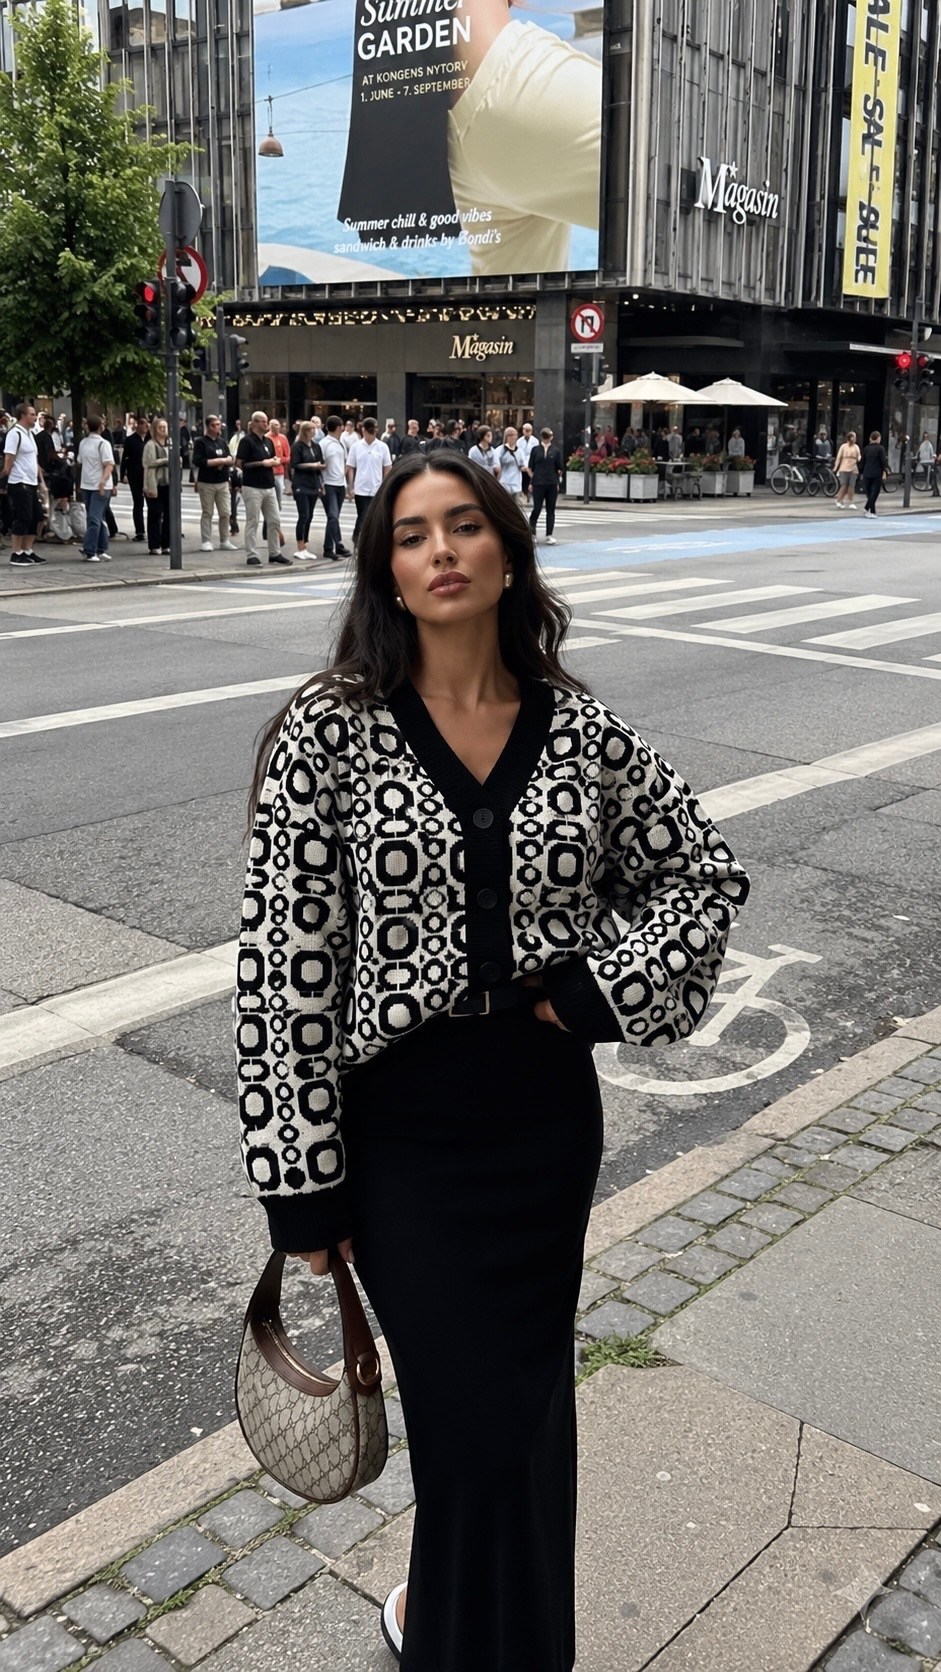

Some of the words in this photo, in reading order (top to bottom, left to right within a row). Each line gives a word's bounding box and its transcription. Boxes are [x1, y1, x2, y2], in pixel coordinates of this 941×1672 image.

[357, 15, 471, 60] GARDEN
[362, 74, 374, 86] AT
[376, 66, 424, 83] KONGENS
[426, 60, 469, 76] NYTORV
[360, 92, 368, 103] 1.
[369, 88, 394, 102] JUNE
[403, 86, 412, 97] 7.
[413, 77, 471, 96] SEPTEMBER
[694, 156, 779, 225] Magasin
[342, 217, 389, 233] Summer
[391, 213, 416, 229] chill
[418, 212, 427, 227] &
[429, 209, 460, 230] good
[462, 207, 493, 223] vibes
[333, 237, 387, 254] sandwich
[389, 235, 399, 250] &
[401, 234, 438, 250] drinks
[440, 232, 454, 249] by
[457, 229, 502, 246] Bondi's
[448, 332, 514, 362] Magasin
